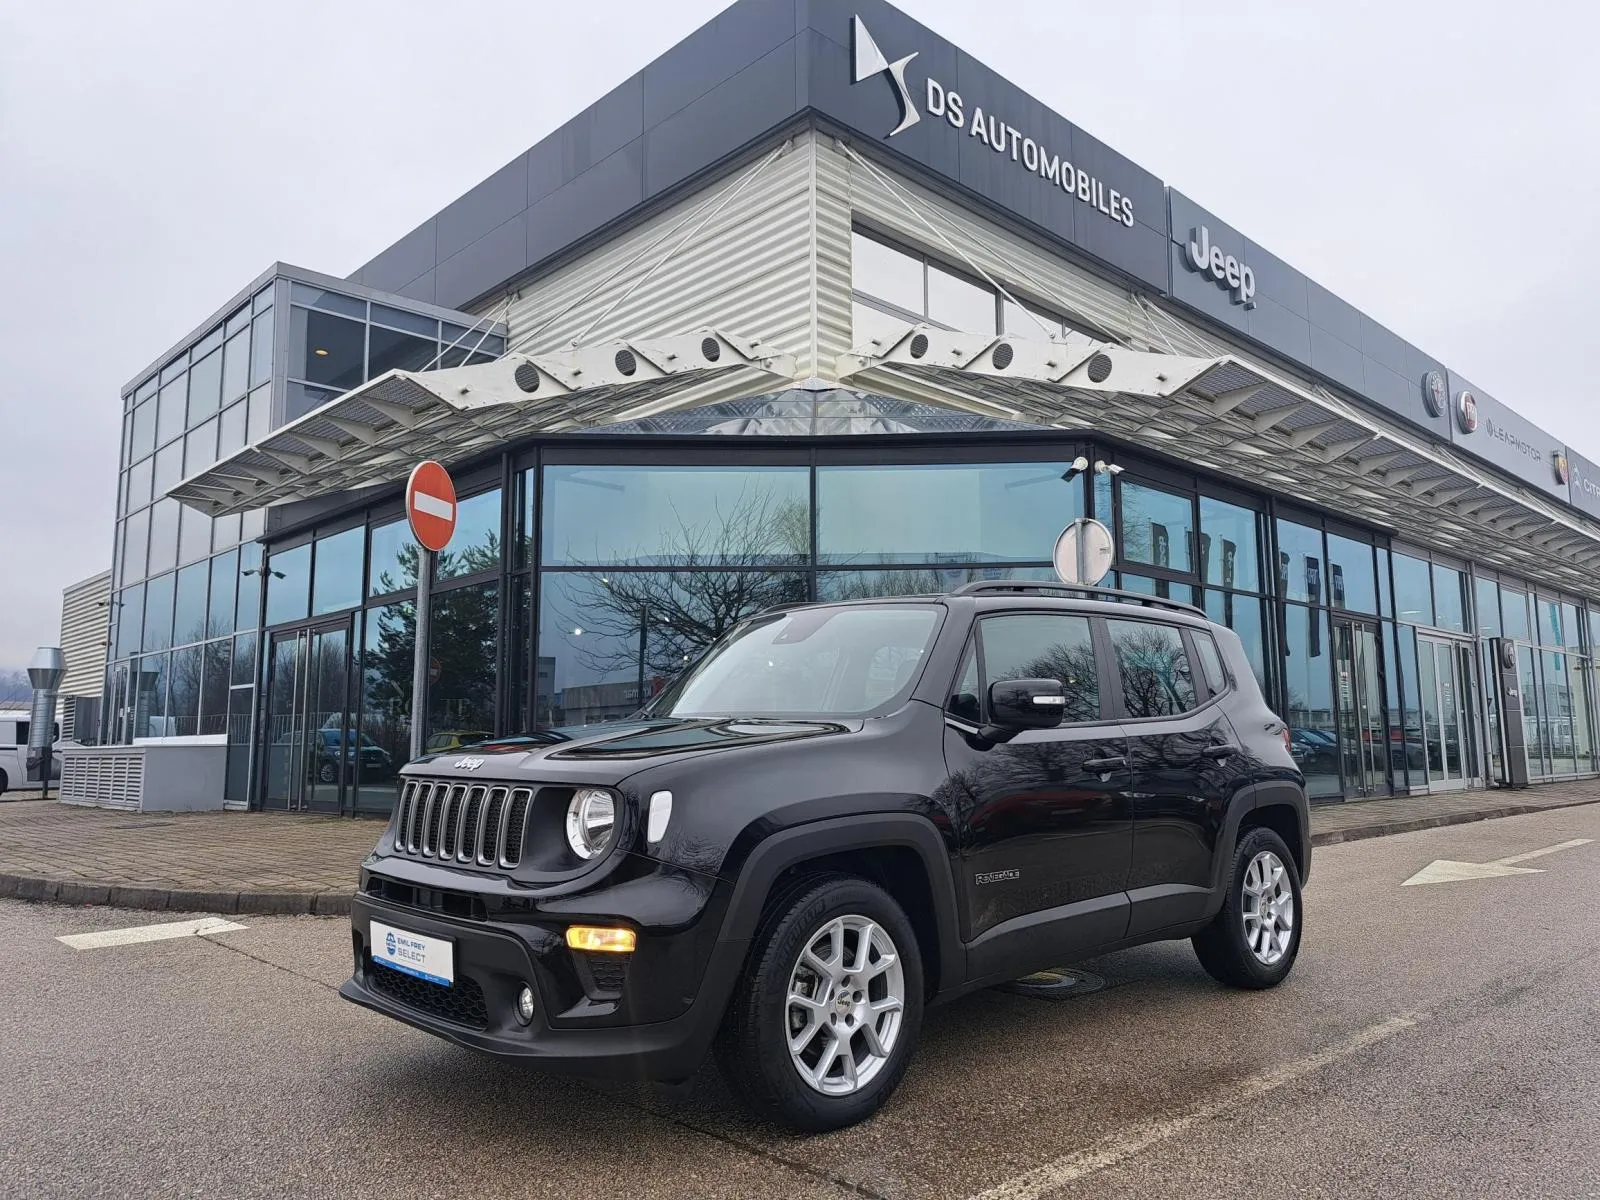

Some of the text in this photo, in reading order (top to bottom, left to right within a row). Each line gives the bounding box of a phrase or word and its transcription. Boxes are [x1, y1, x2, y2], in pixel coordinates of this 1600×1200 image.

[926, 76, 1134, 228] DS AUTOMOBILES
[1191, 226, 1256, 306] Jeep
[1493, 427, 1541, 462] LEAPMOTOR
[454, 756, 485, 772] Jeep
[397, 938, 426, 951] EMIL FREY
[397, 948, 426, 963] SELECT
